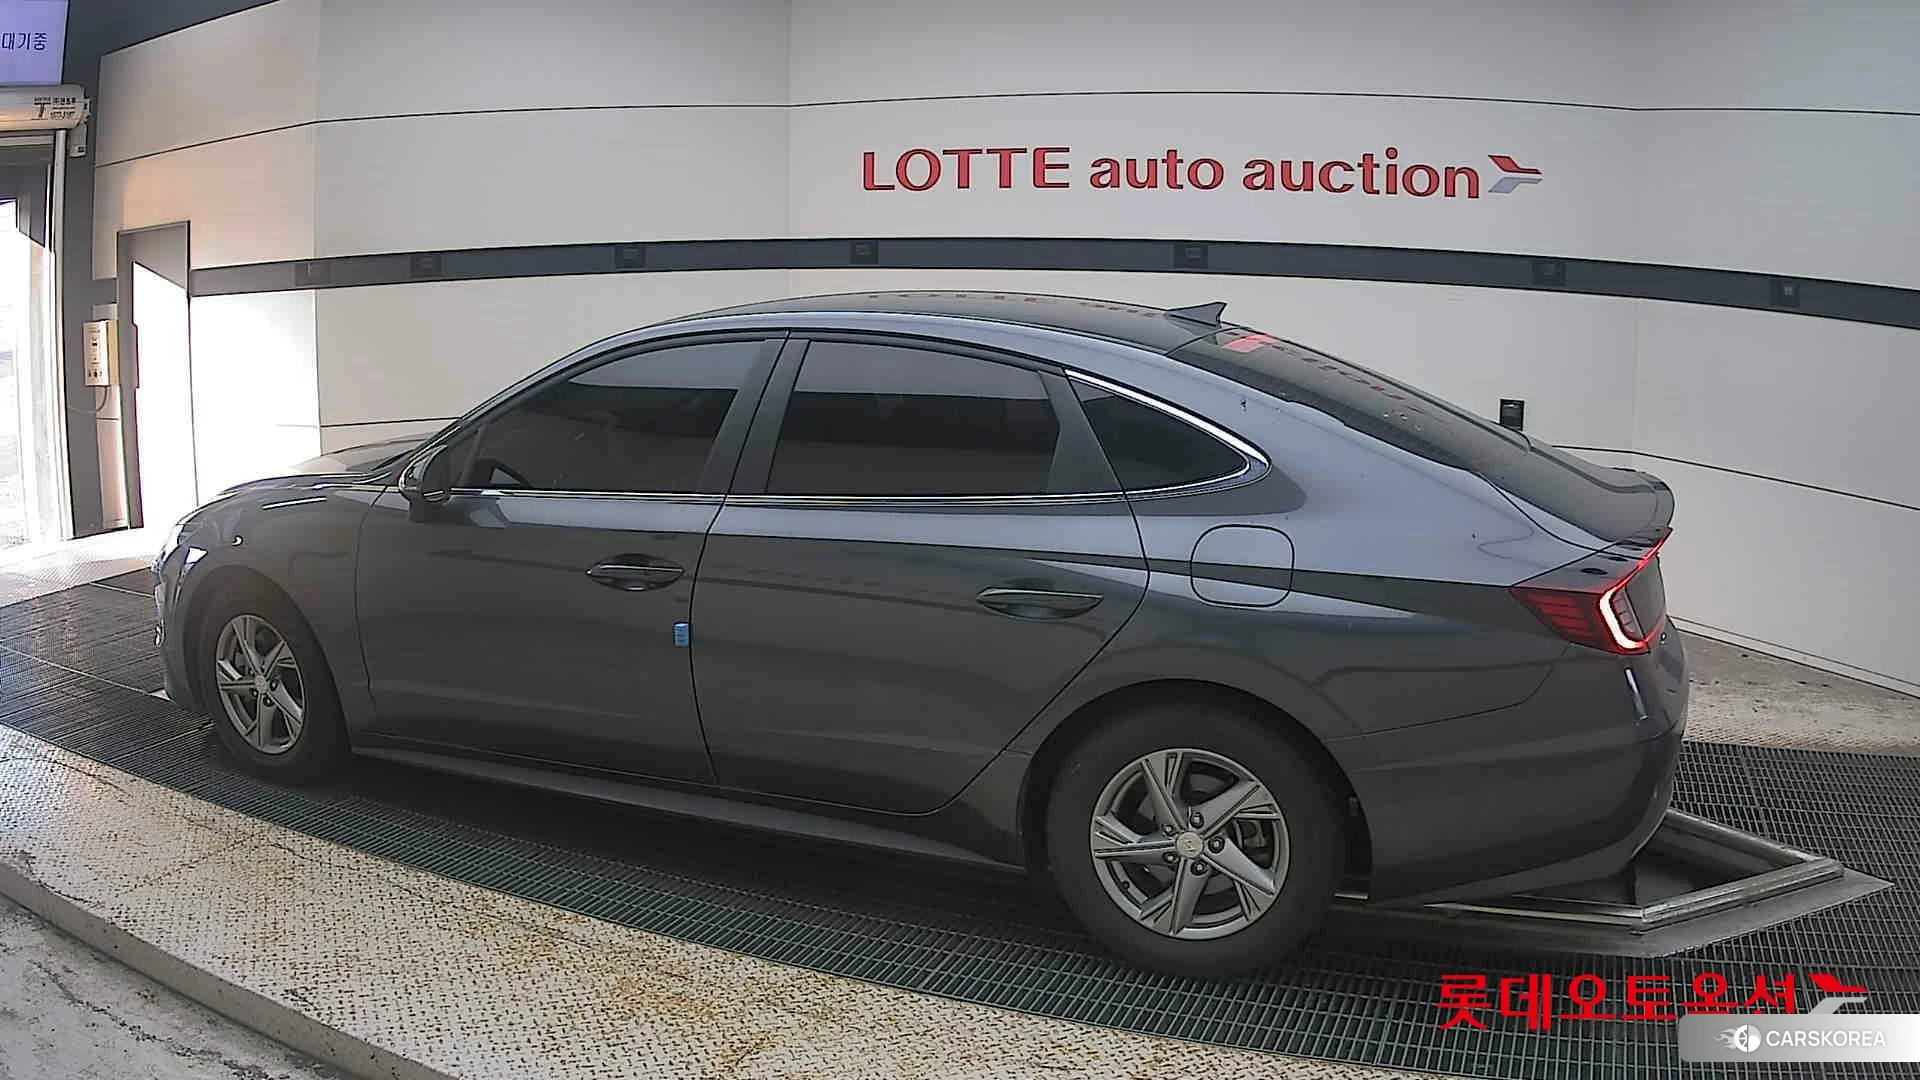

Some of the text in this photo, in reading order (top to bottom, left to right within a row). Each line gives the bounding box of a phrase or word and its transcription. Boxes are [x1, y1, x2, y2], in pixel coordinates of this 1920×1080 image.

[863, 147, 1480, 199] LOTTE auto auction
